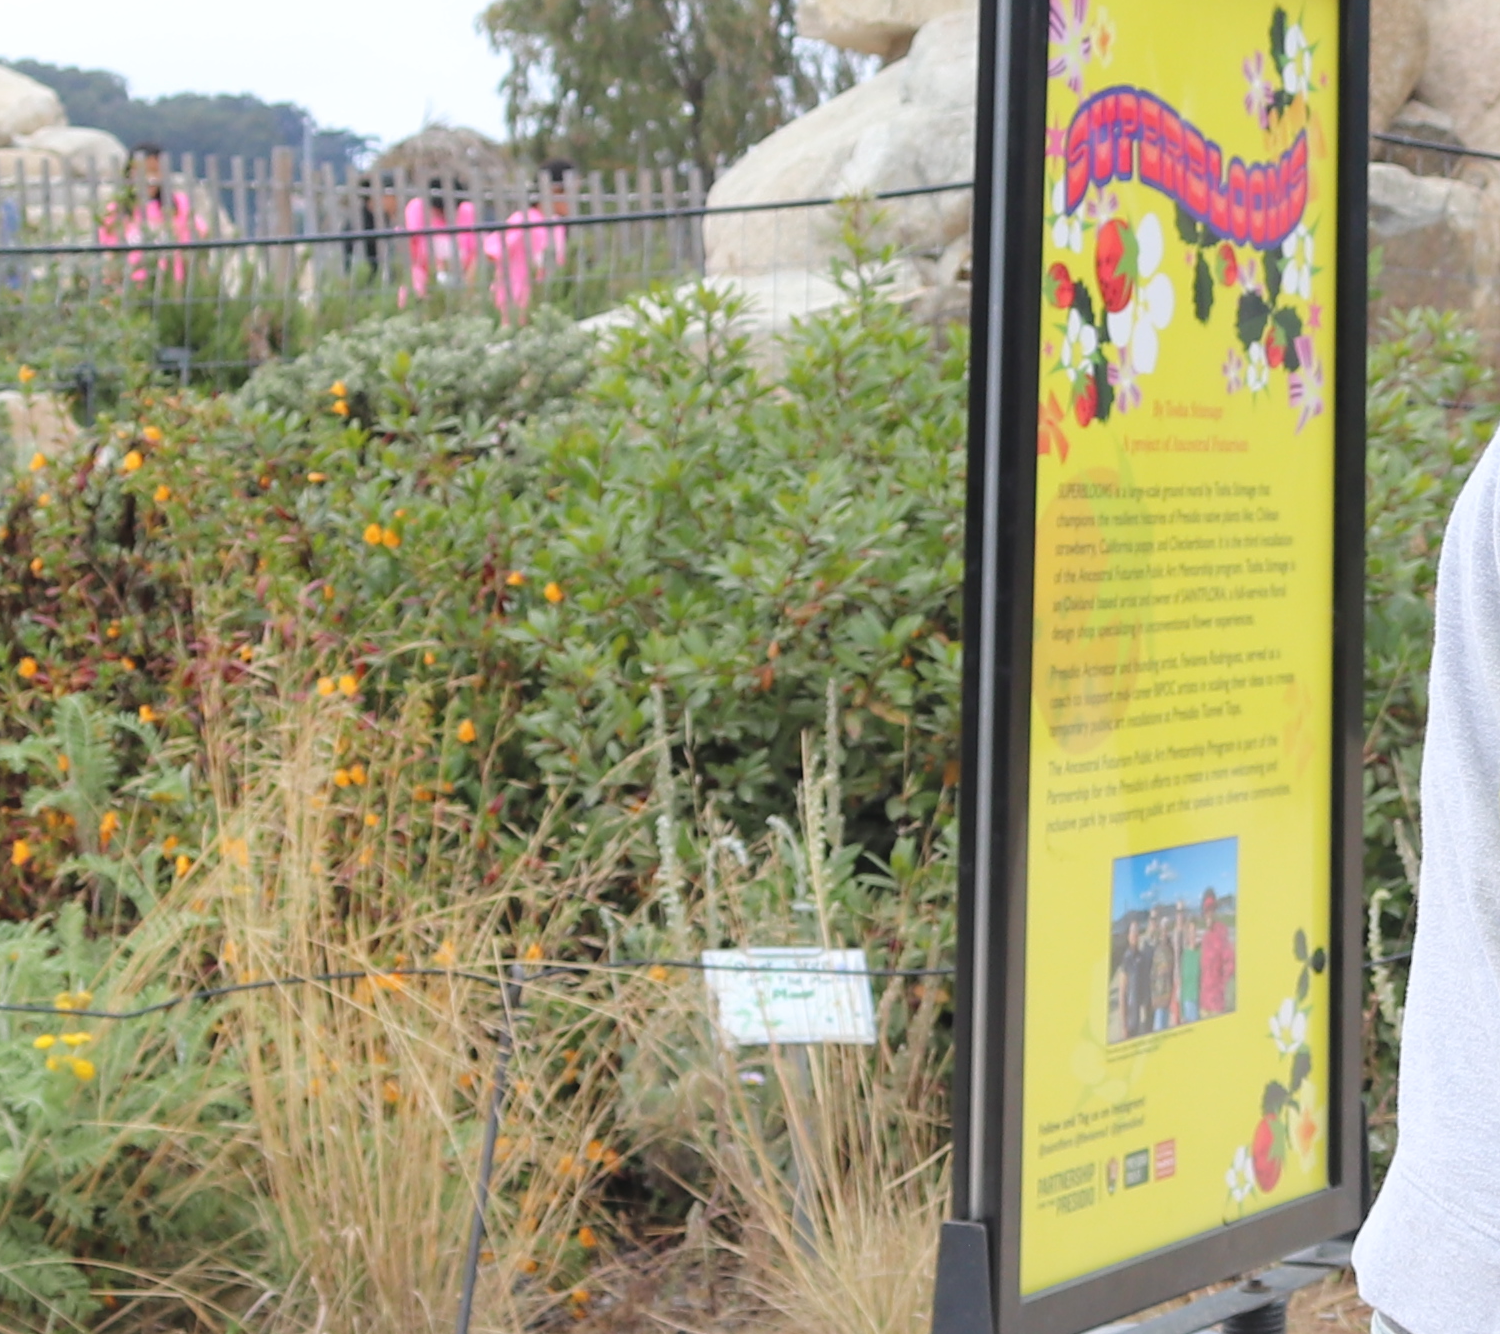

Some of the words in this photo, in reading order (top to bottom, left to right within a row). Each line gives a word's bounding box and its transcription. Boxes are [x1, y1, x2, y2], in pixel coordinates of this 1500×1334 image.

[1065, 85, 1309, 251] SUPERBLOOMS
[1058, 483, 1114, 498] SUPERBLOOMS
[1048, 760, 1065, 777] The
